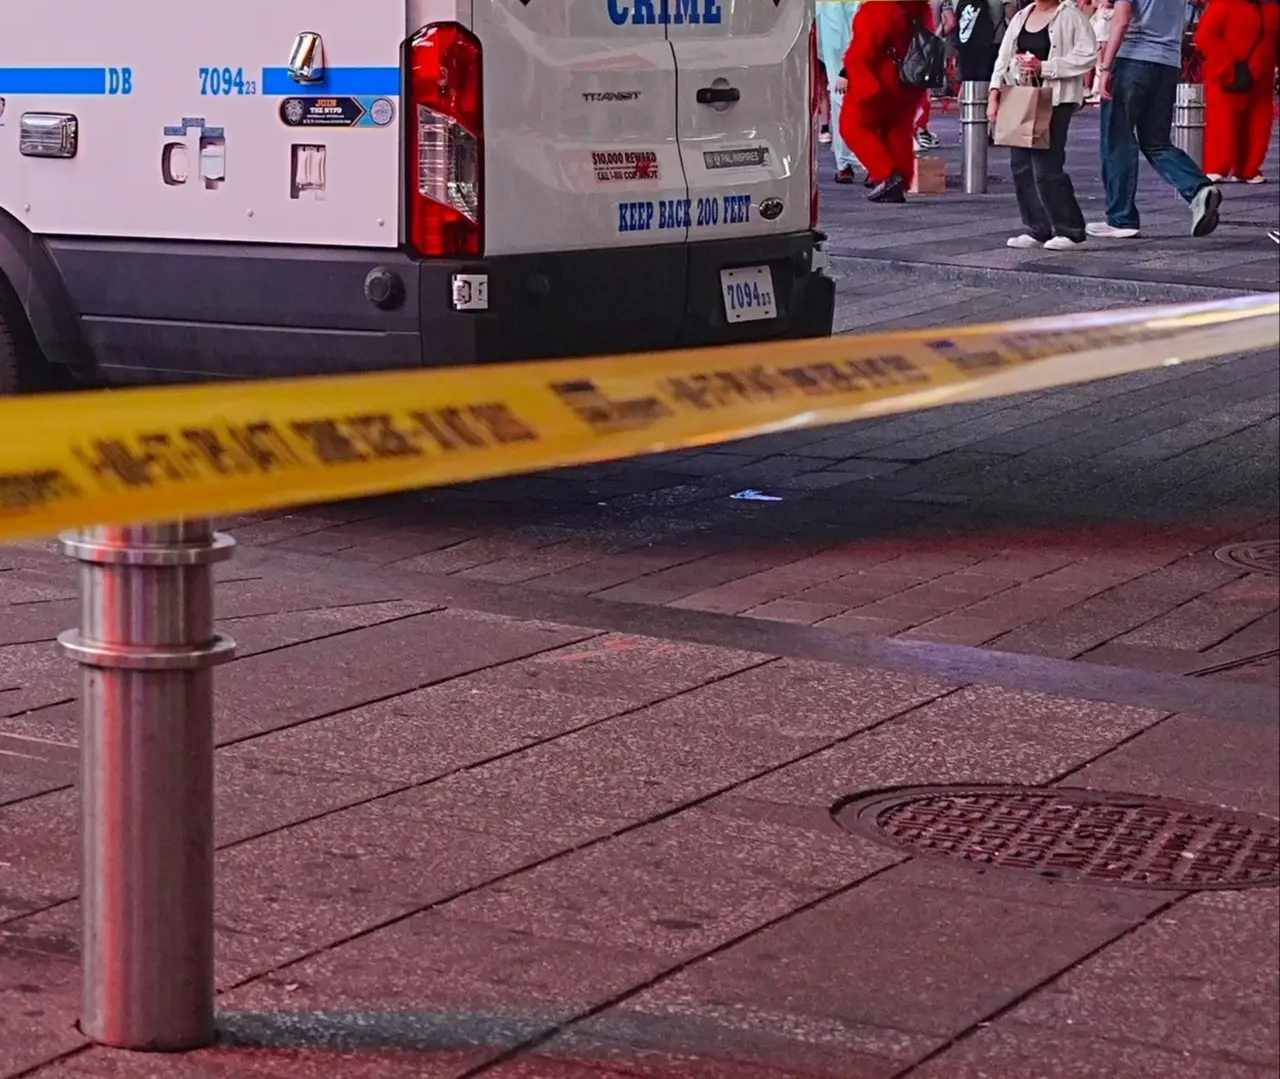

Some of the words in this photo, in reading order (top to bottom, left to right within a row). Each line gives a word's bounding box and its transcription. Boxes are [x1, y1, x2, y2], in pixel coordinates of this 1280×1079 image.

[108, 68, 132, 95] DB
[315, 99, 337, 107] JOIN
[592, 152, 623, 165] $10,000
[618, 201, 653, 232] KEEP
[658, 199, 692, 229] BACK
[697, 197, 719, 226] 200
[723, 195, 751, 224] FEET
